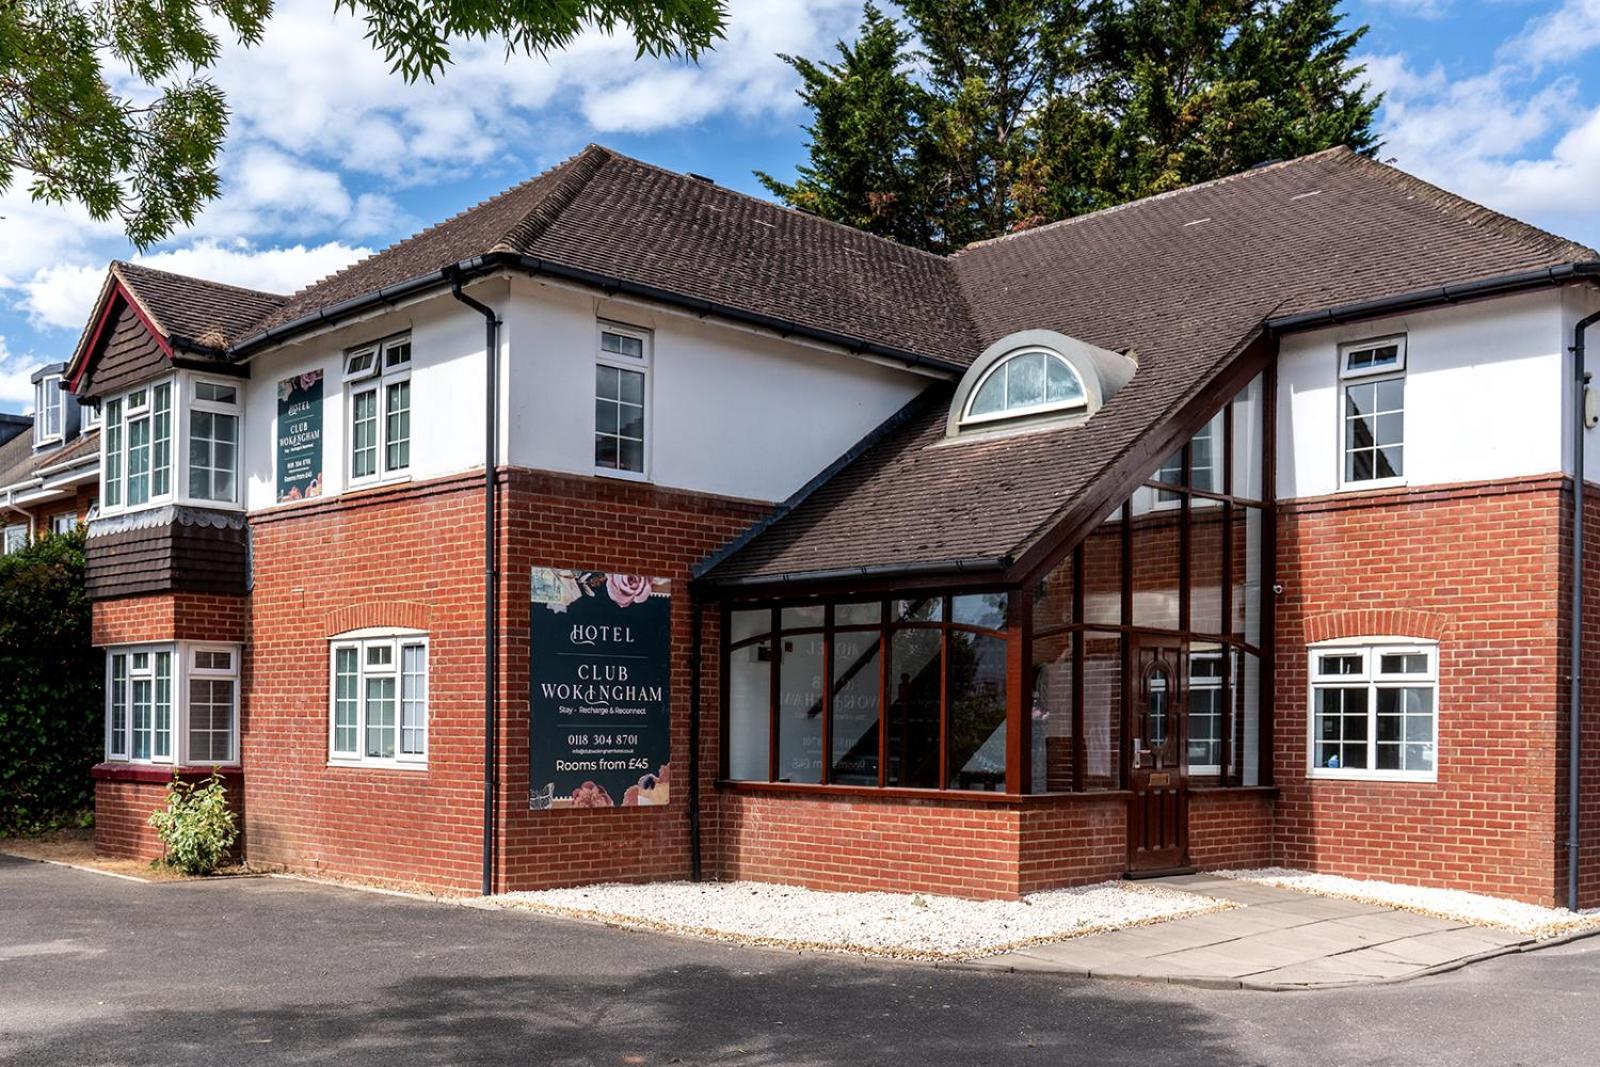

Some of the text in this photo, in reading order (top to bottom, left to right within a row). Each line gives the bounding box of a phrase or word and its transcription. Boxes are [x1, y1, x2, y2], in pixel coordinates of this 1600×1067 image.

[290, 422, 308, 434] CLUB
[570, 624, 635, 646] HOTEL
[578, 664, 628, 681] CLUB
[541, 683, 662, 706] WOKINGHAM
[559, 706, 573, 715] Stay
[579, 706, 609, 716] Recharge
[609, 706, 614, 714] &
[615, 706, 647, 715] Reconnect
[568, 734, 638, 746] 0118 304 8701
[556, 758, 649, 772] Rooms from £45
